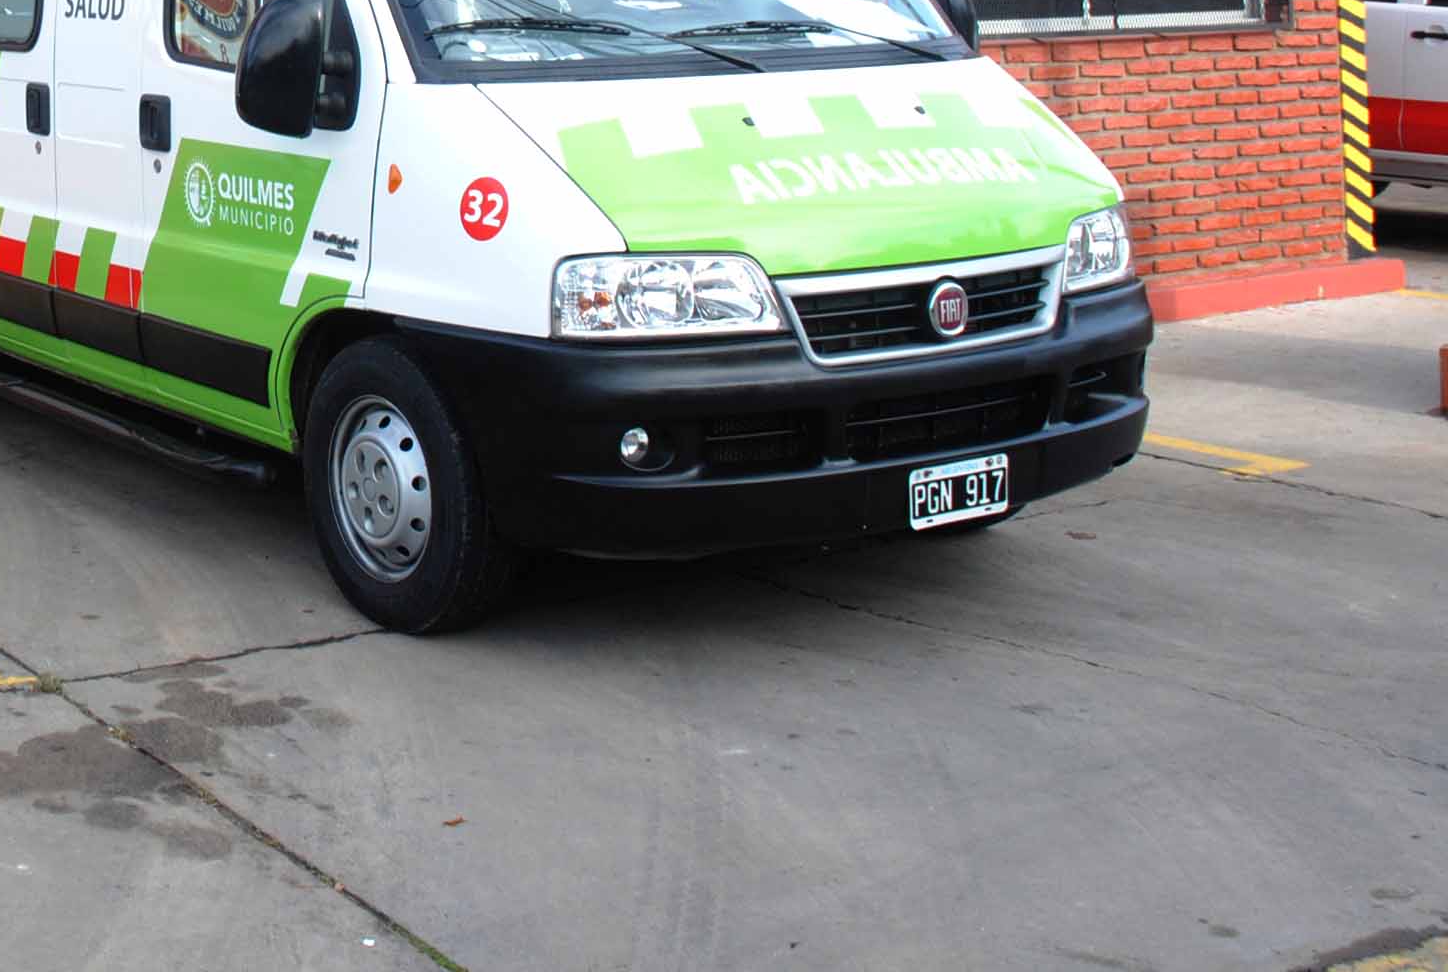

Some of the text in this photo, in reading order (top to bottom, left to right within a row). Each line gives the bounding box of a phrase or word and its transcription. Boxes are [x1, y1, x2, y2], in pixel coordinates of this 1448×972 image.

[218, 172, 294, 211] QUILMES
[464, 189, 503, 227] 32
[218, 204, 294, 236] MUNICIPIO
[940, 298, 961, 324] FIAT
[914, 469, 1004, 517] PGN 917
